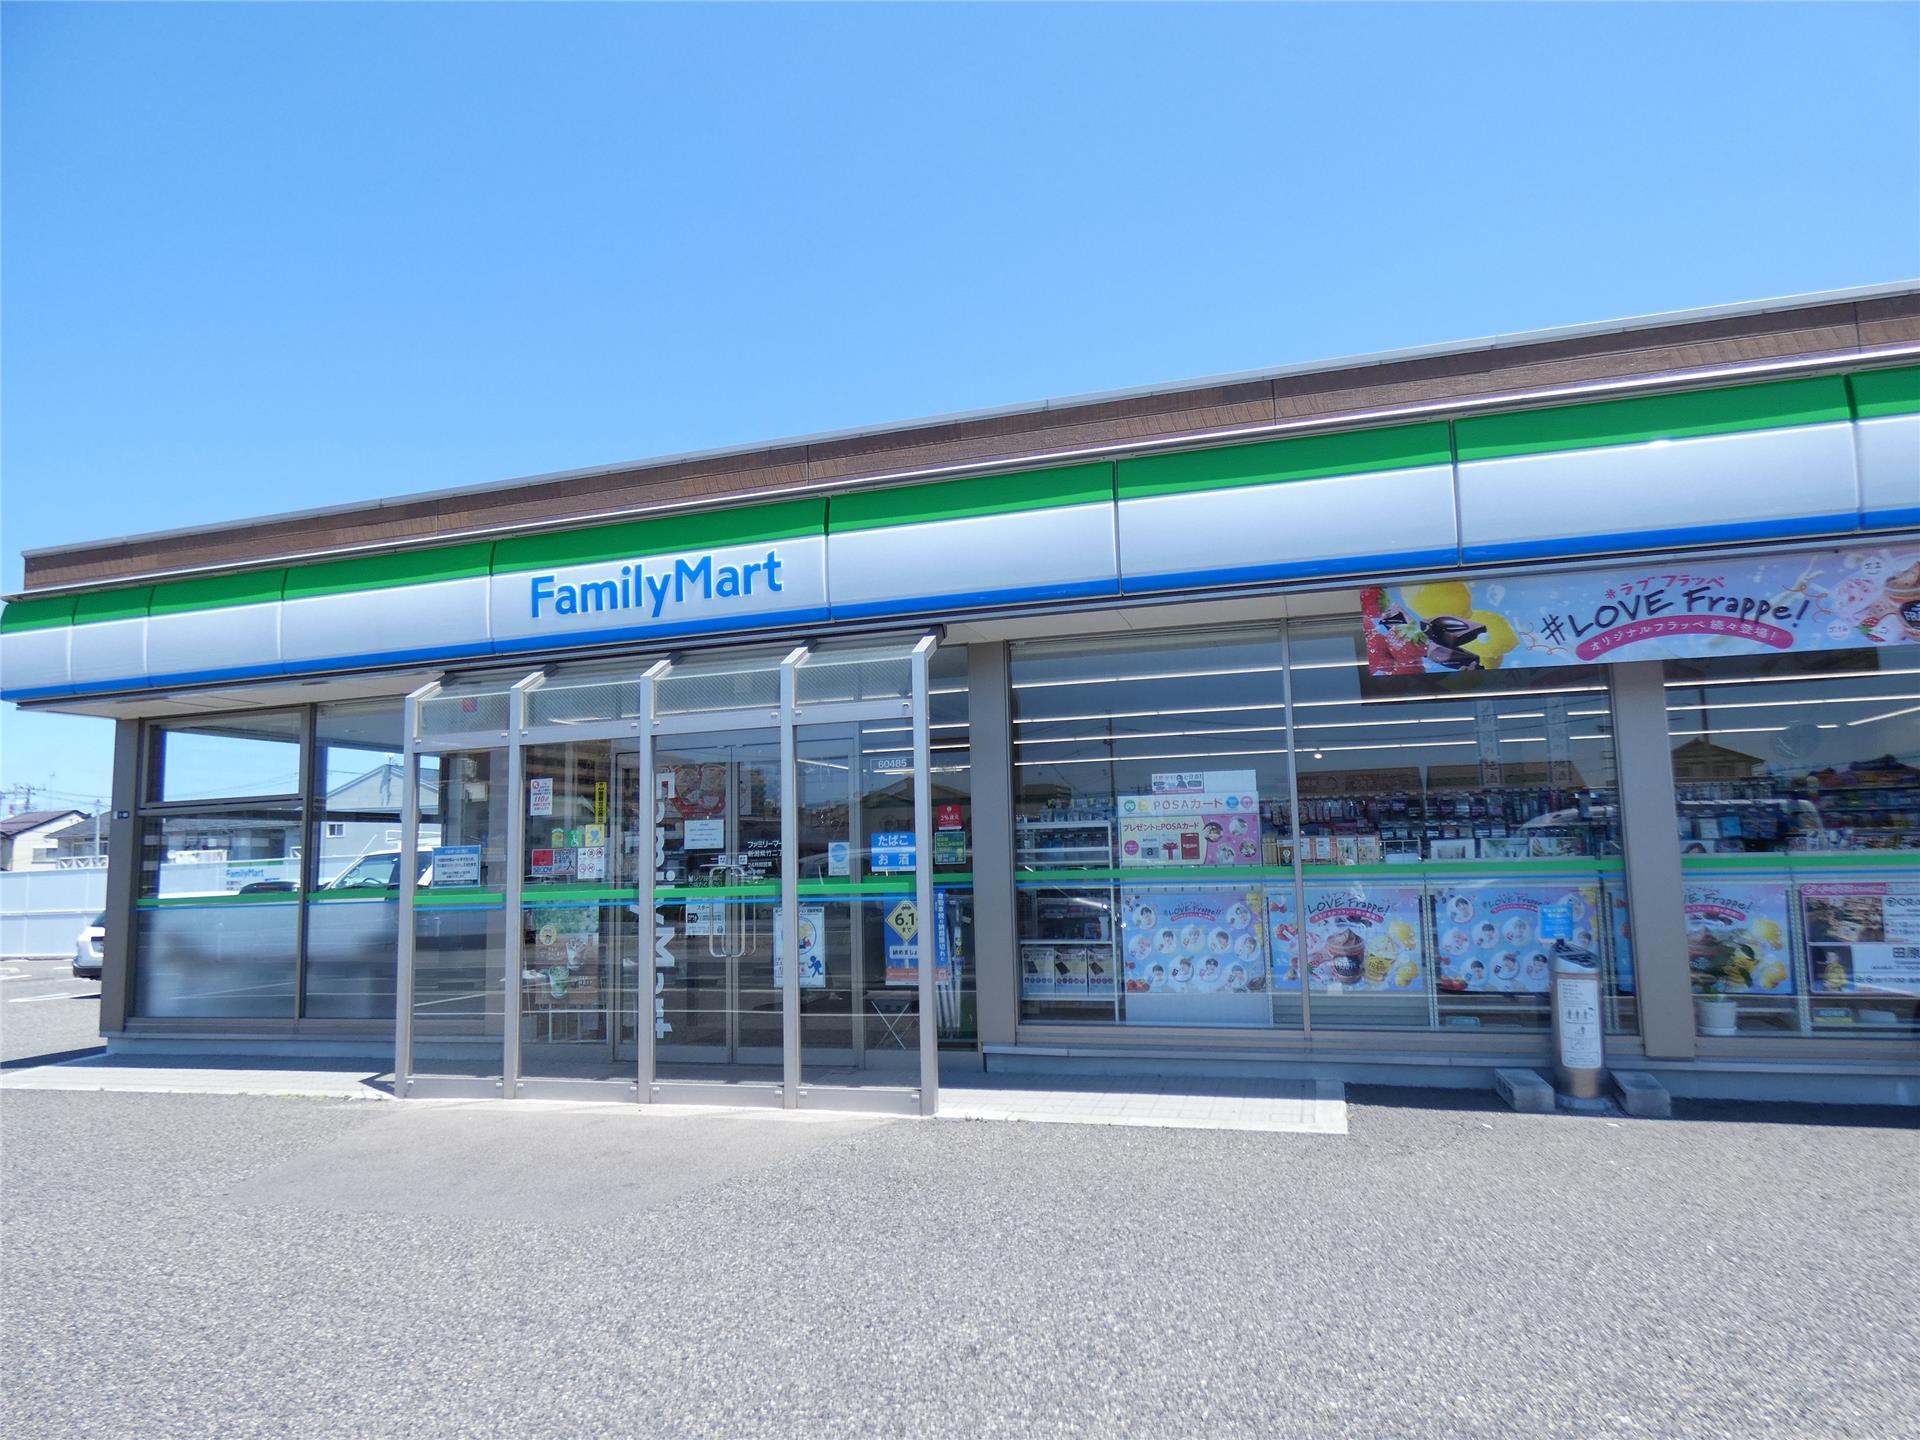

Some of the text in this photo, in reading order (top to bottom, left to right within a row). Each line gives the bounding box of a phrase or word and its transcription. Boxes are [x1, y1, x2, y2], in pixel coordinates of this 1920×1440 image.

[530, 549, 784, 618] FamilyMart
[1540, 586, 1810, 646] #LOVE Frappe!
[878, 759, 907, 769] 60485
[1153, 797, 1223, 811] POSAカード
[1123, 822, 1200, 832] プレゼントにPOSAカード
[747, 840, 782, 848] ファミリーマー
[878, 835, 909, 847] たばこ
[878, 853, 909, 865] お酒
[1305, 896, 1345, 915] LOVE
[894, 912, 915, 926] 6.1
